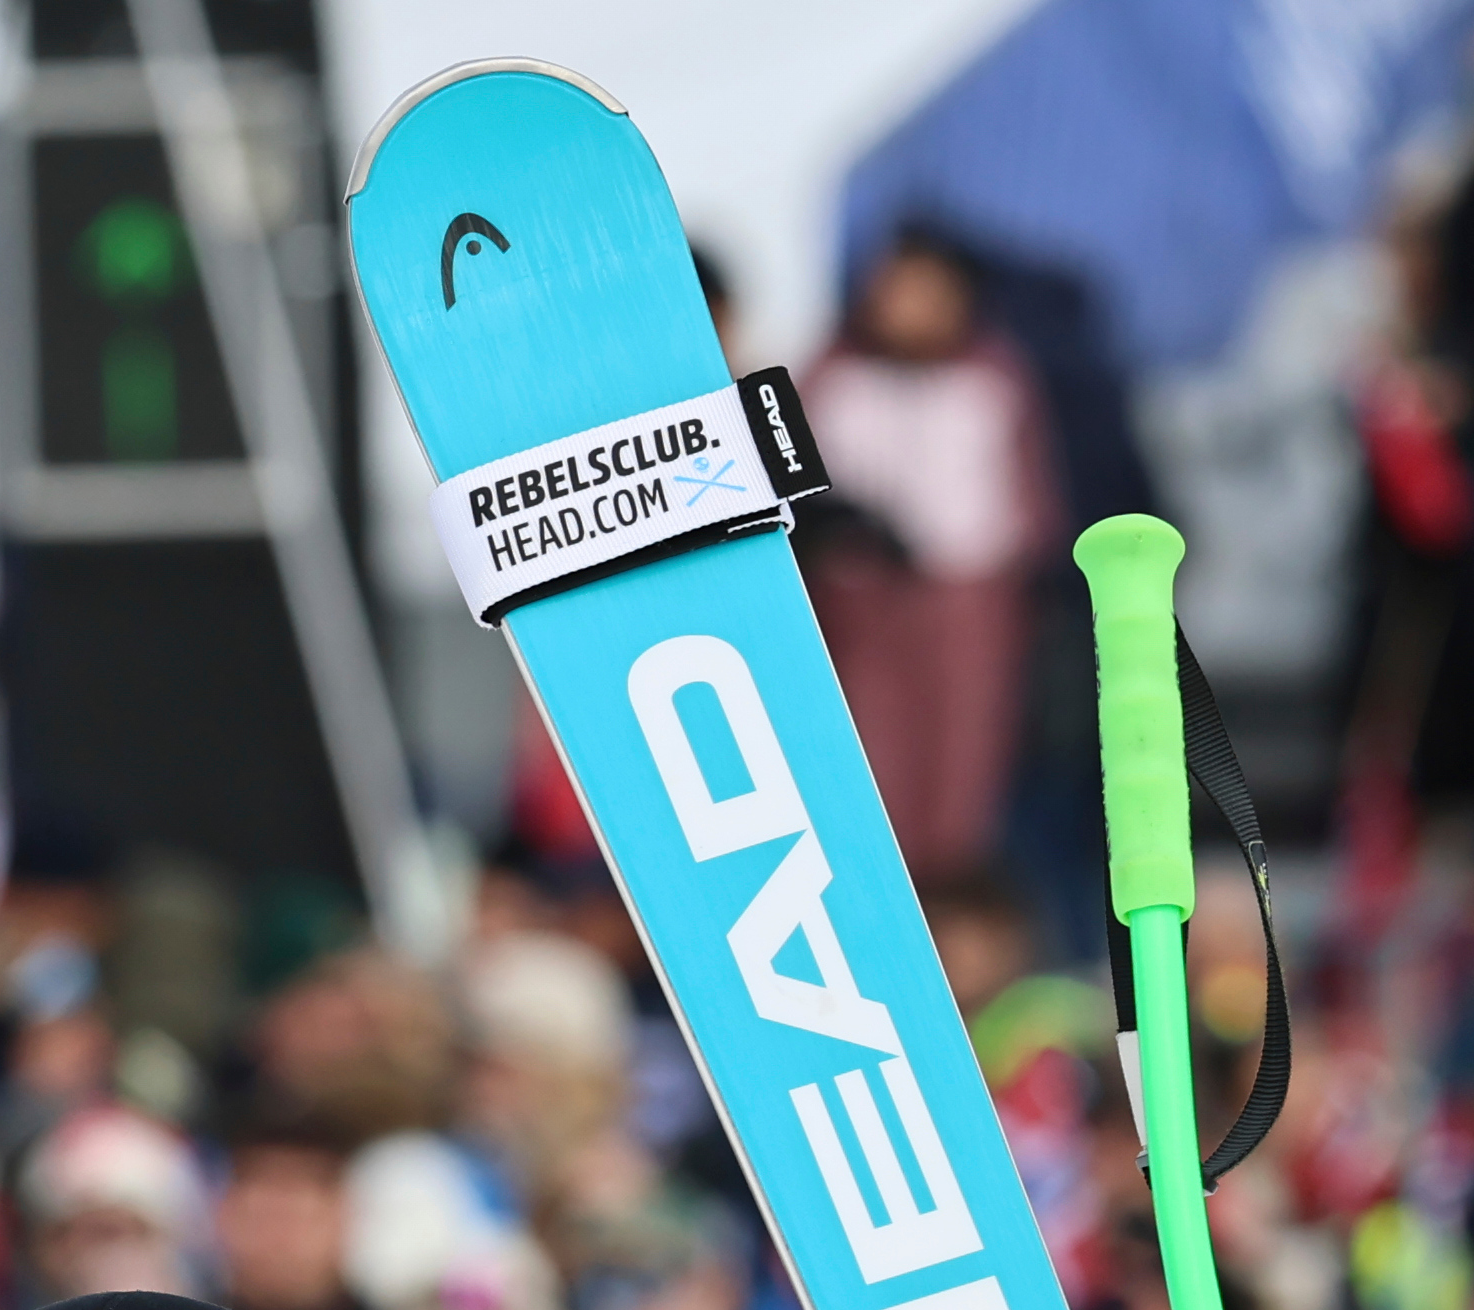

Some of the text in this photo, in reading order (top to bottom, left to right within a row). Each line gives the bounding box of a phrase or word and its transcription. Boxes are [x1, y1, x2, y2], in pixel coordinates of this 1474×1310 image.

[469, 417, 721, 528] REBELSCLUB.
[758, 383, 804, 474] HEAD
[486, 479, 669, 573] HEAD.COM
